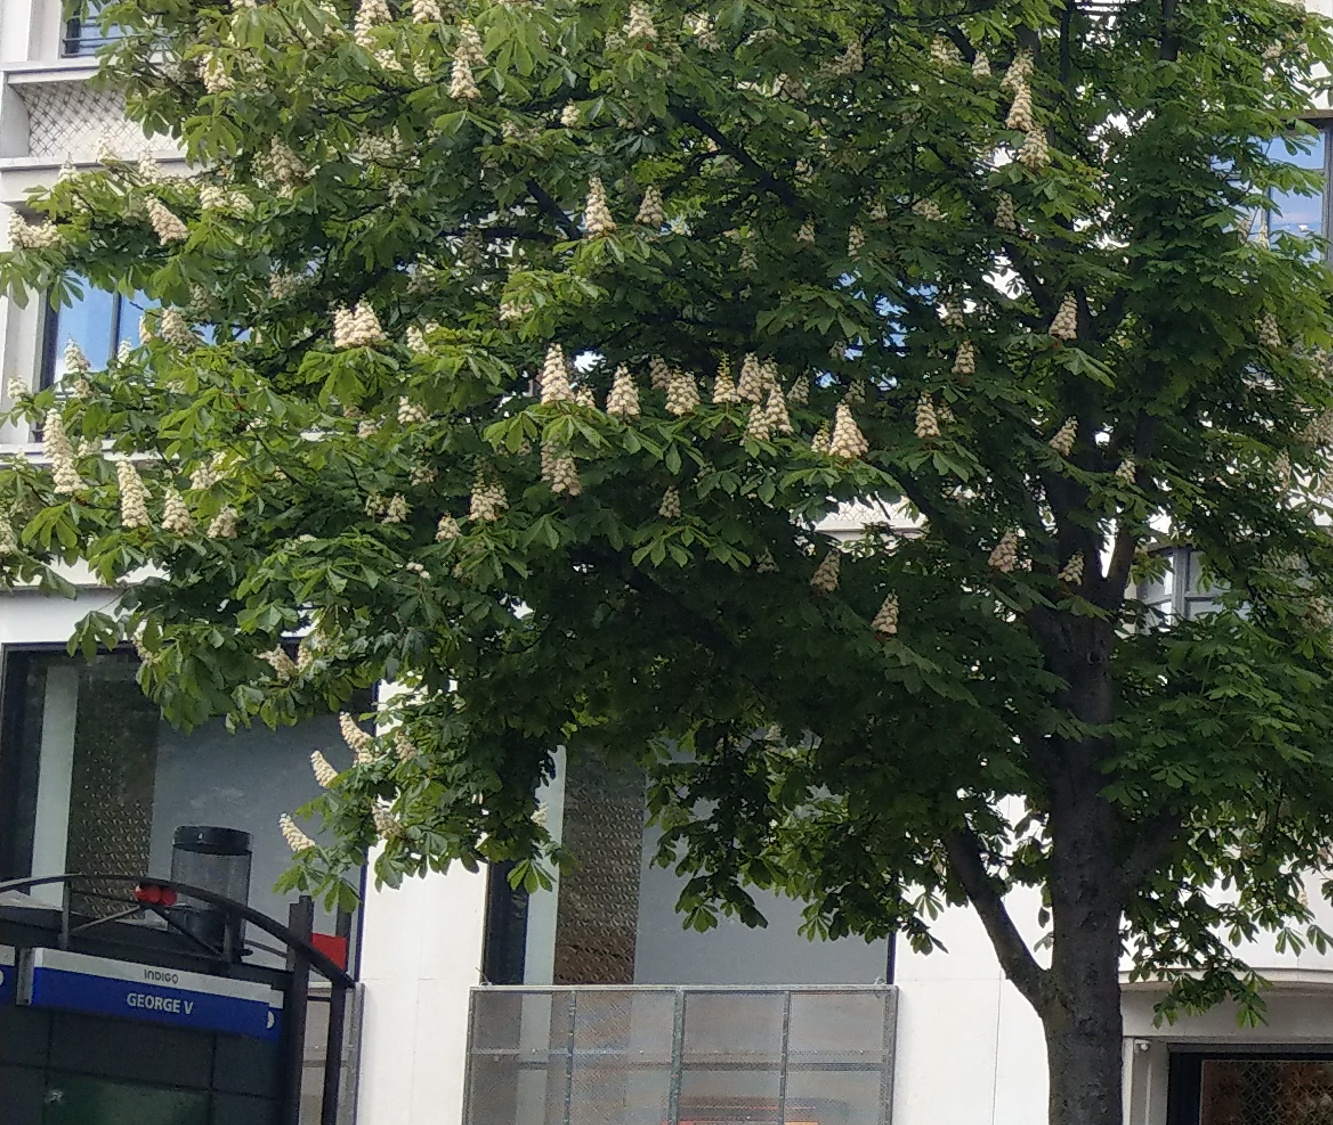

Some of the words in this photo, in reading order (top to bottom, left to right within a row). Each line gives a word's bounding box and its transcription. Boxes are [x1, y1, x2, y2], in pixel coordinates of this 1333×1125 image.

[144, 968, 179, 985] INDIGO
[126, 992, 181, 1014] GEORGE
[184, 1000, 194, 1015] V
